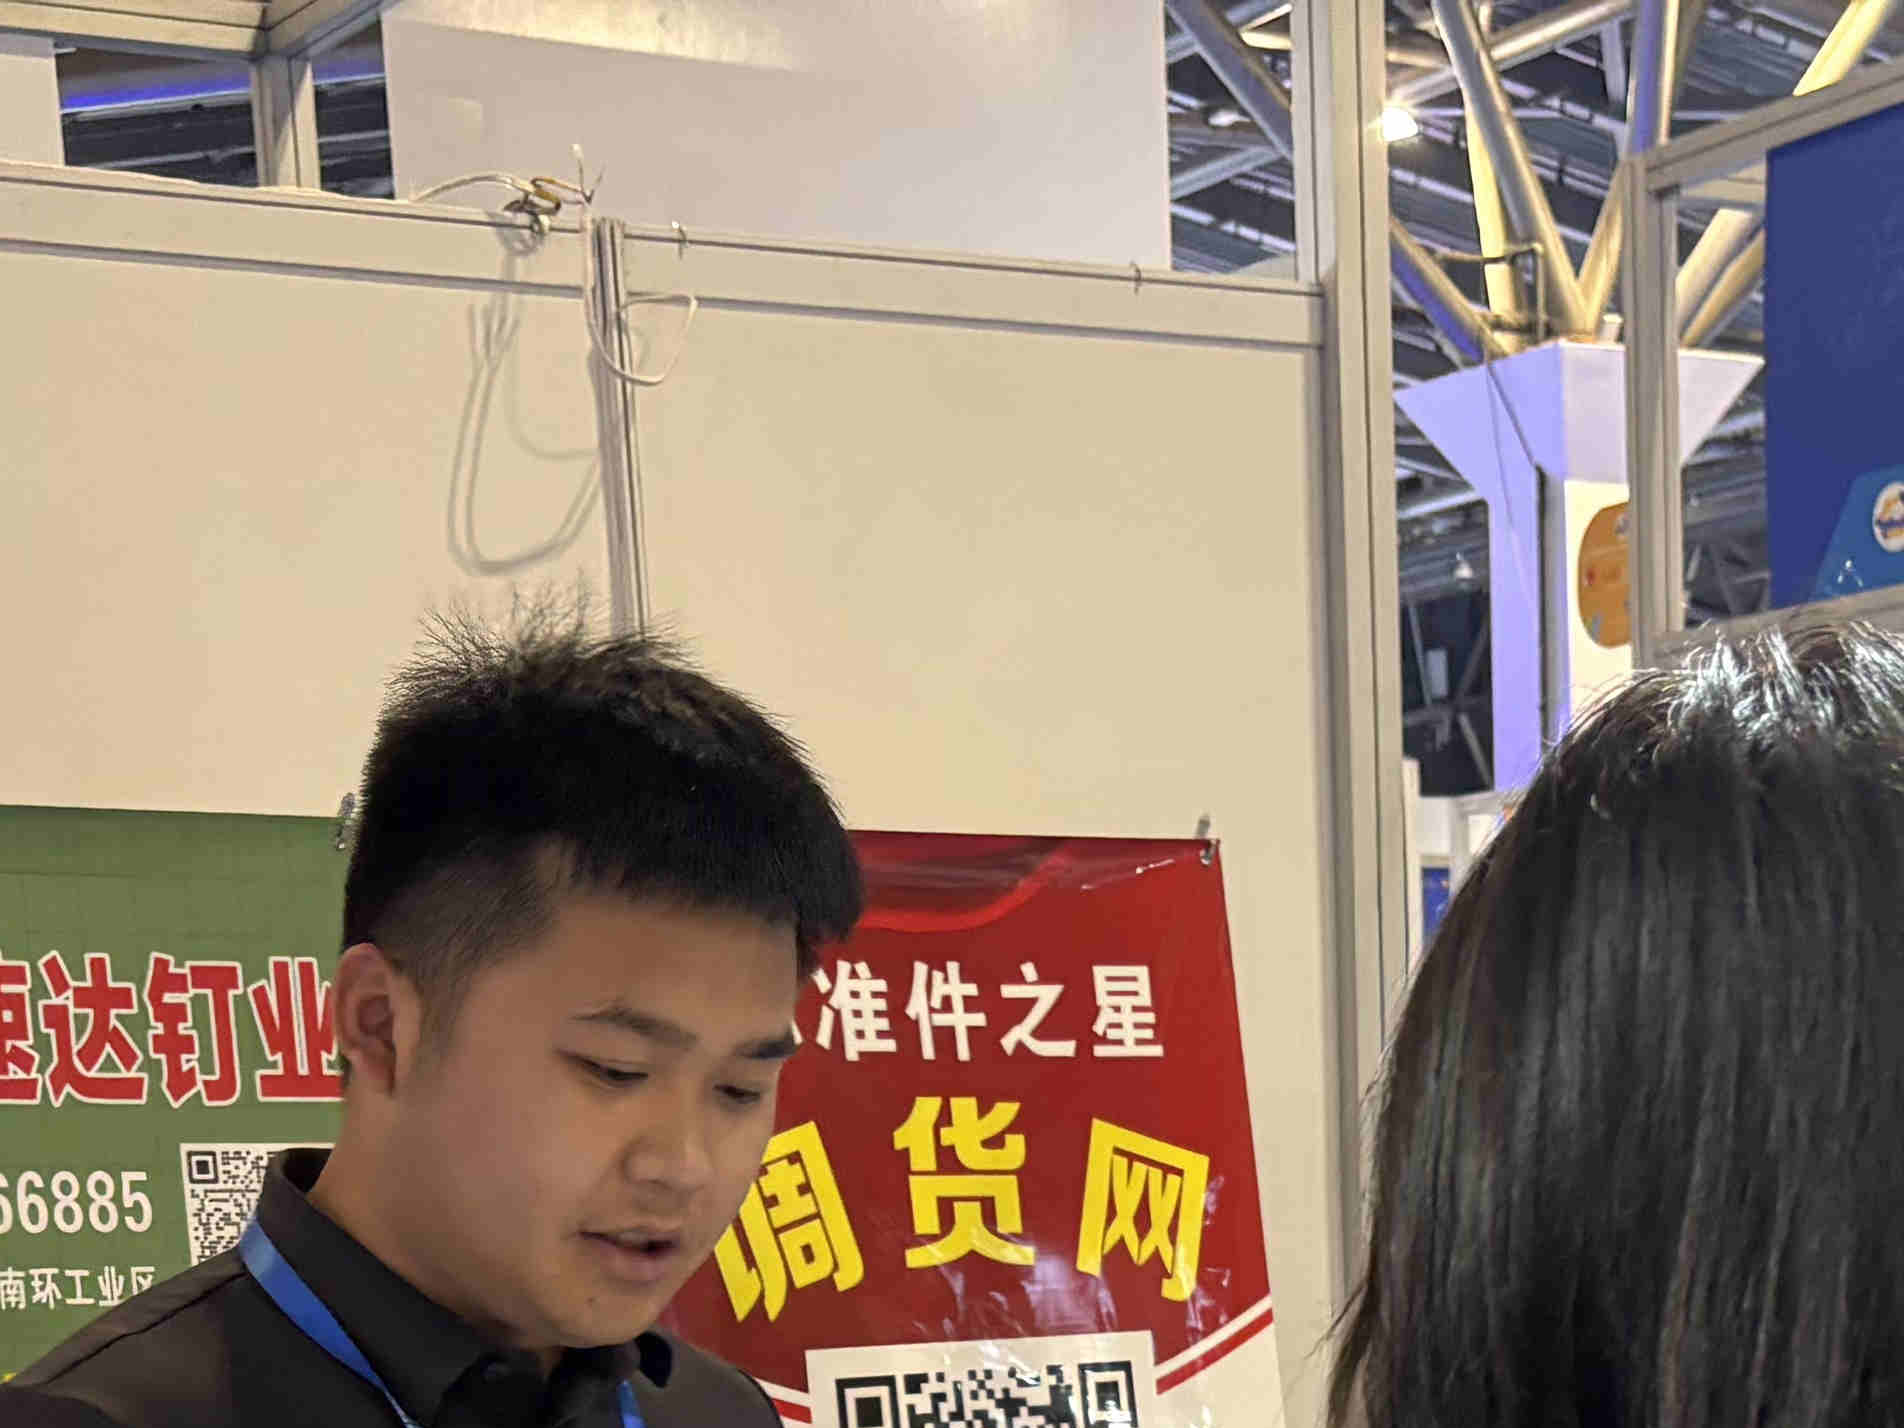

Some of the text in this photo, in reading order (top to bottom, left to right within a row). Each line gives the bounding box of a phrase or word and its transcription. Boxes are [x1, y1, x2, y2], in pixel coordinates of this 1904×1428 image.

[791, 959, 1165, 1062] 准件之星
[714, 1096, 1210, 1323] 调货网
